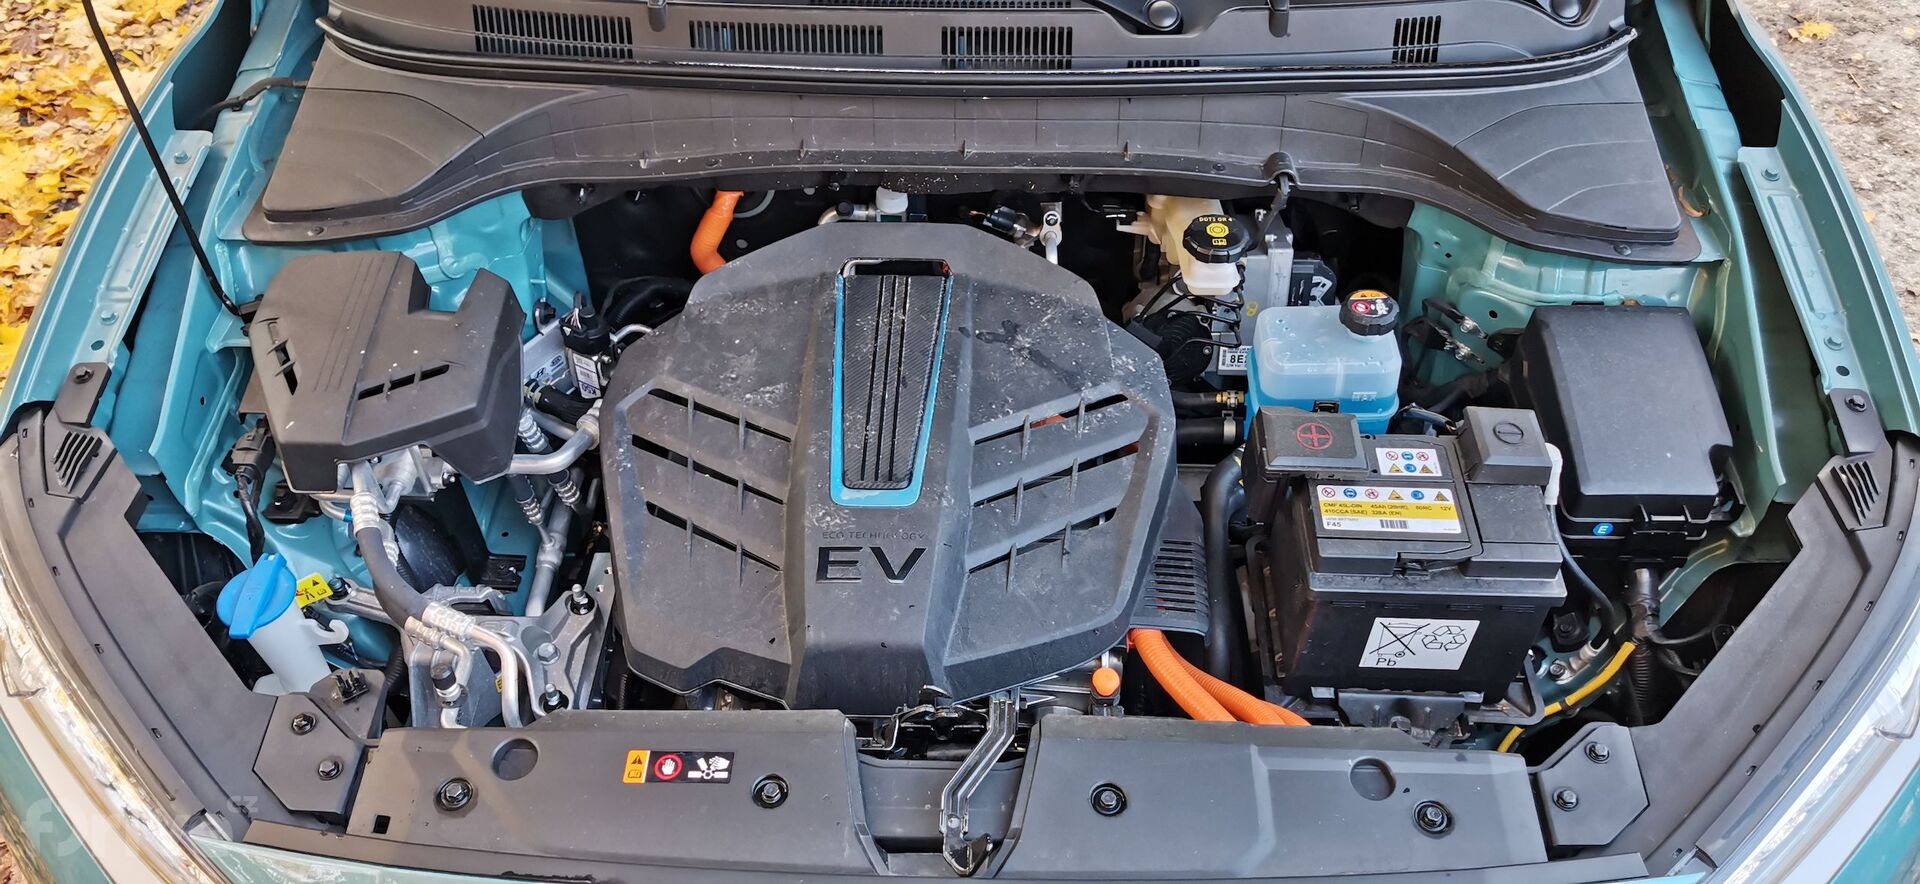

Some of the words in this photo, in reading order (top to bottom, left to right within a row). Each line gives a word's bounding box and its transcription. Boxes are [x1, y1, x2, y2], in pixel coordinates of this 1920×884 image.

[1230, 355, 1247, 364] 8E
[1597, 525, 1609, 534] E
[822, 531, 845, 539] ECO
[816, 546, 928, 584] EV
[1375, 657, 1397, 667] Pb
